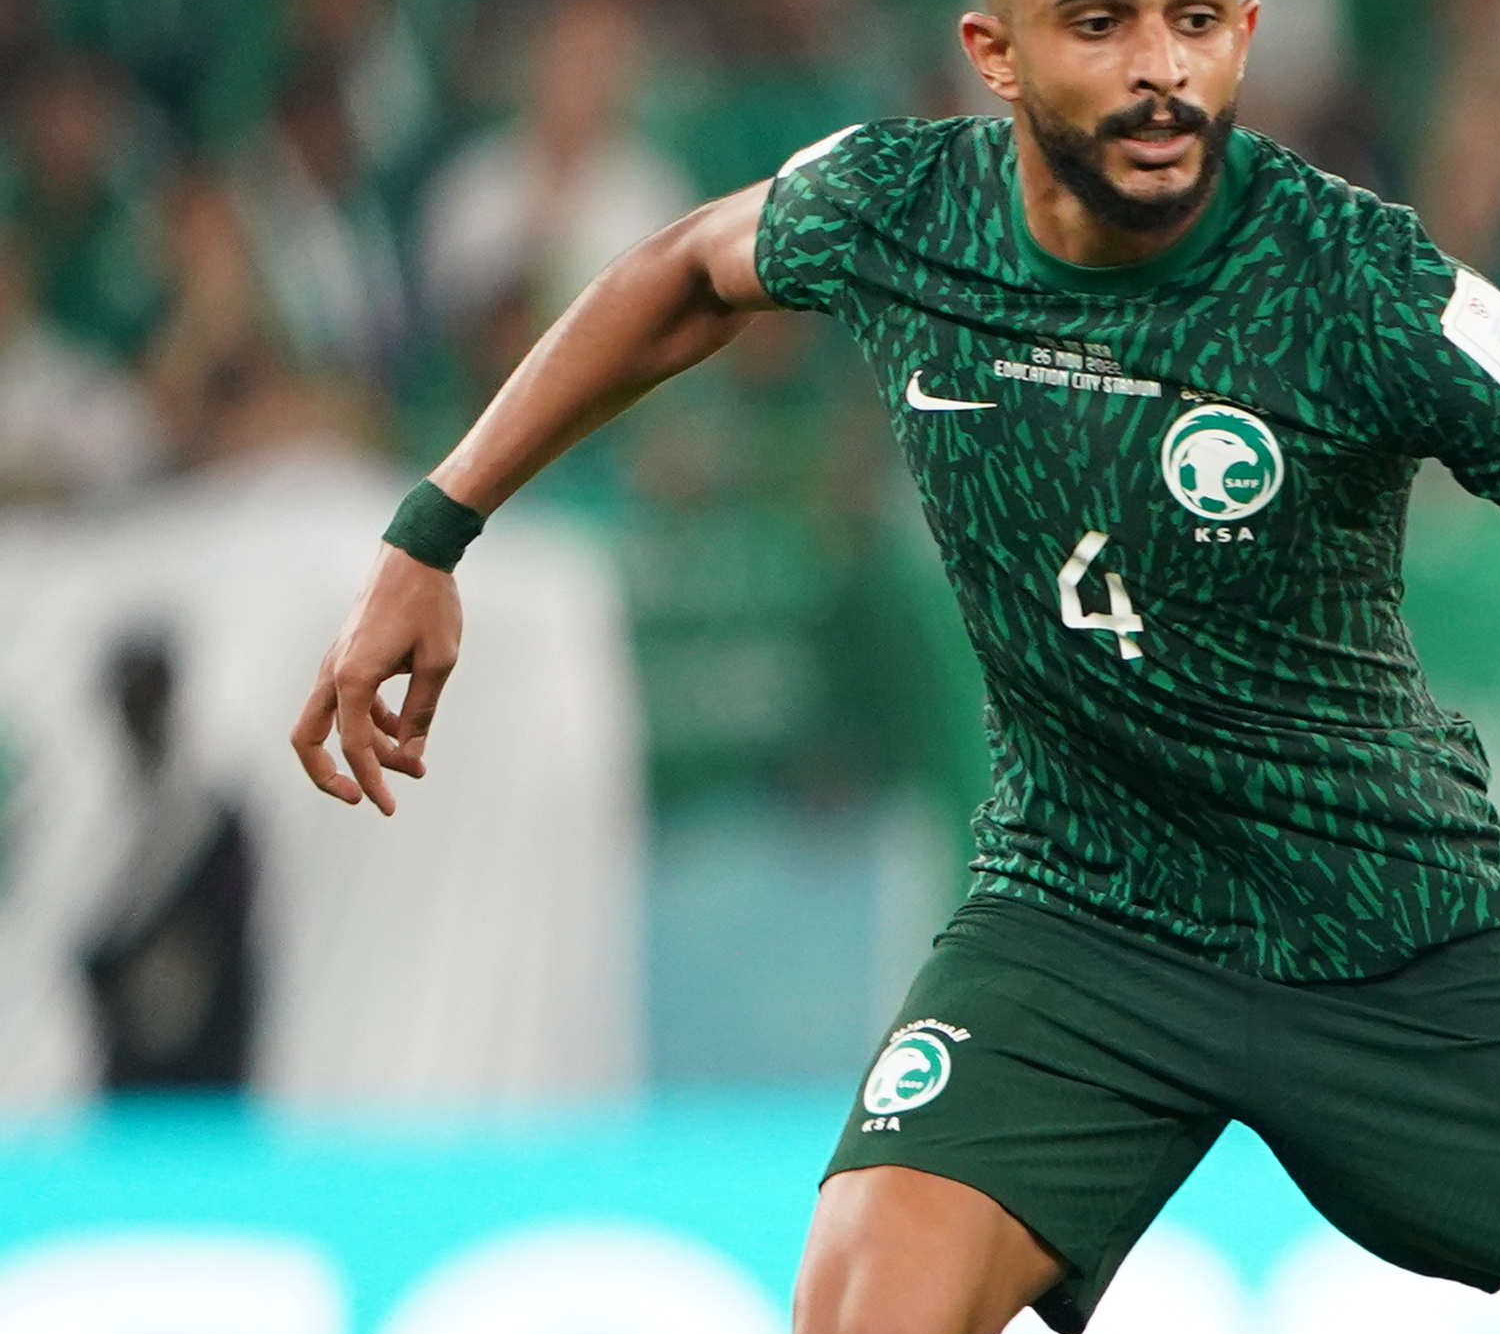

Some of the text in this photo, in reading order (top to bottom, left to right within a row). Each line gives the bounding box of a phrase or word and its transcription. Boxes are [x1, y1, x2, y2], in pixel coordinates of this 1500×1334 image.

[994, 360, 1069, 387] EDUCATION
[1071, 372, 1100, 392] CITY
[1225, 478, 1260, 489] SAFF
[1194, 527, 1255, 543] KSA
[1057, 530, 1144, 660] 4
